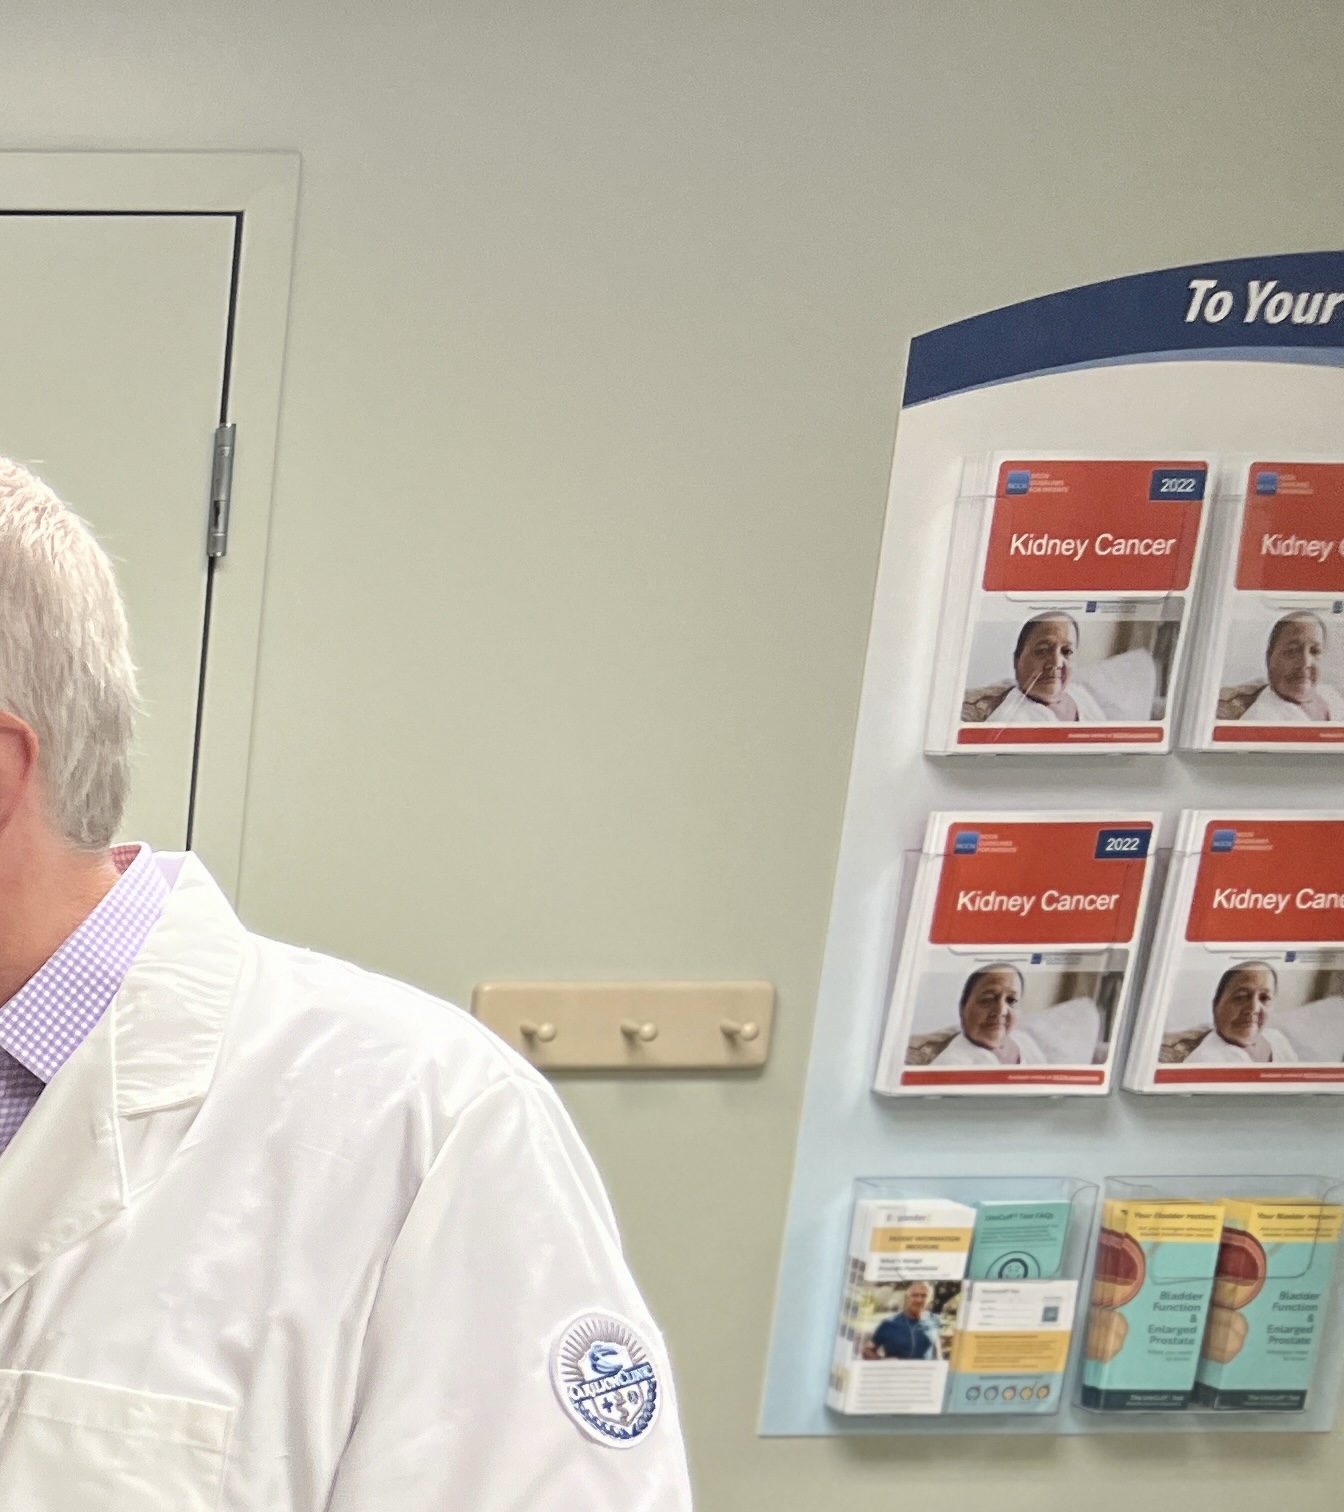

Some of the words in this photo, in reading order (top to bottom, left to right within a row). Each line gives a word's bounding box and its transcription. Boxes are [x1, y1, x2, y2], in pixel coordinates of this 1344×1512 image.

[1184, 279, 1234, 323] To
[1243, 279, 1344, 325] Your
[1160, 478, 1196, 493] 2022
[1010, 533, 1089, 561] Kidney
[1095, 533, 1176, 556] Cancer
[1261, 534, 1332, 562] Kidney
[1105, 838, 1140, 851] 2022
[957, 890, 1036, 916] Kidney
[1041, 890, 1120, 911] Cancer
[1213, 888, 1292, 914] Kidney
[1160, 1290, 1204, 1301] Bladder
[1278, 1290, 1321, 1301] Bladder
[1152, 1302, 1201, 1312] Function
[1272, 1302, 1319, 1312] Function
[1189, 1314, 1198, 1323] &
[1306, 1314, 1314, 1323] &
[1147, 1324, 1197, 1335] Enlarged
[1266, 1324, 1314, 1335] Enlarged
[1149, 1336, 1196, 1345] Prostate
[1267, 1336, 1312, 1345] Prostate
